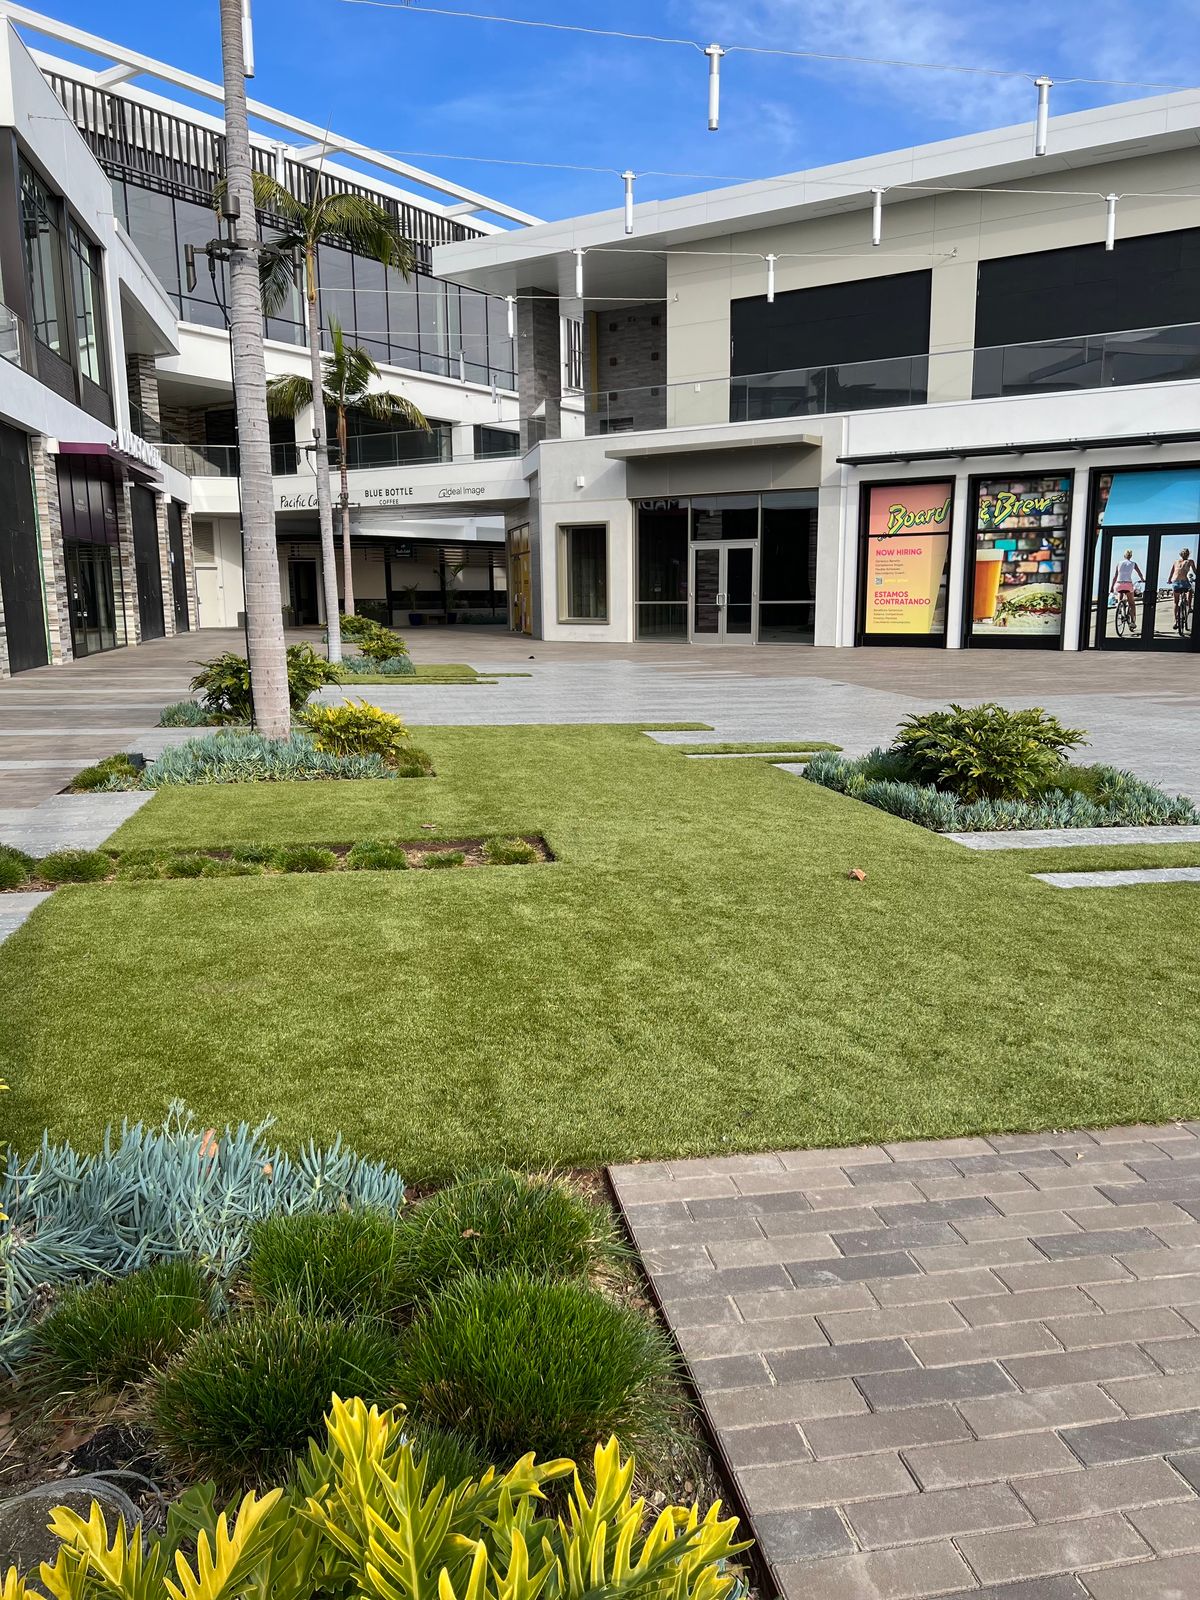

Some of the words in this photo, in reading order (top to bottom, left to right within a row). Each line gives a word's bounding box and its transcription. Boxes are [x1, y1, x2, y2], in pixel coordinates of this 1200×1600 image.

[364, 489, 383, 498] BLUE
[385, 487, 414, 497] BOTTLE
[463, 486, 485, 496] Image
[280, 494, 306, 509] Pacific
[308, 494, 320, 507] Ca
[887, 497, 951, 536] Board
[993, 491, 1052, 527] Brew
[875, 549, 895, 557] NOW
[896, 548, 923, 556] HIRING
